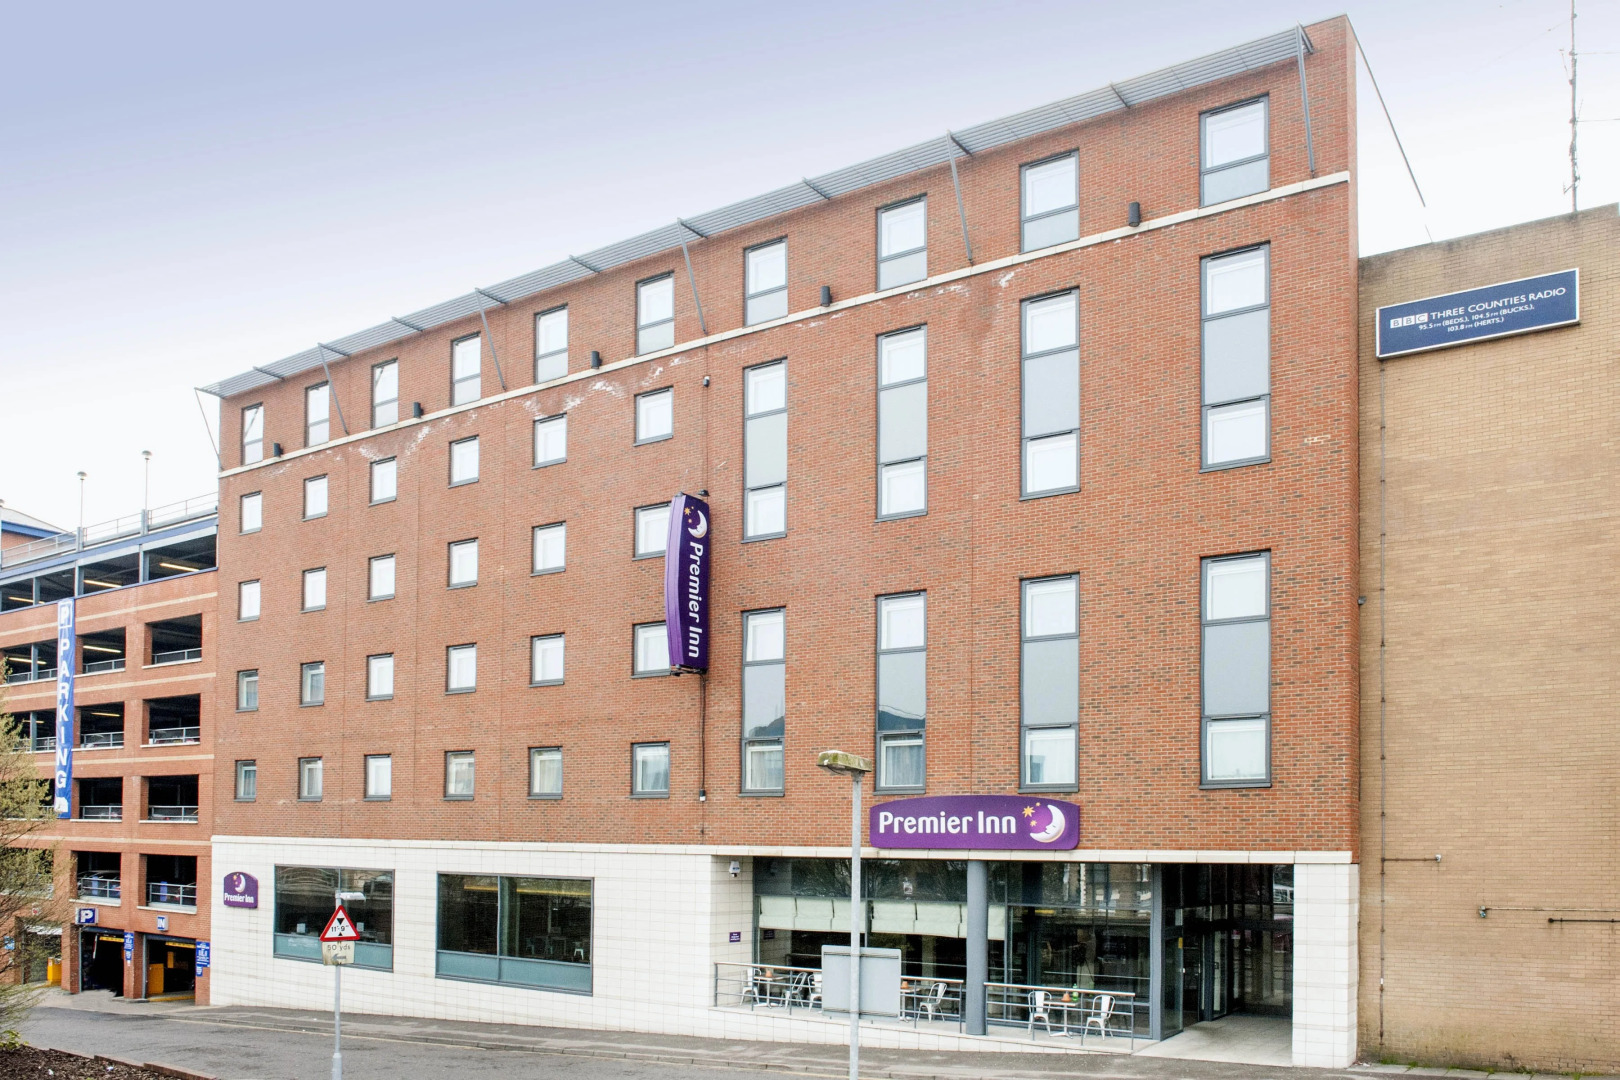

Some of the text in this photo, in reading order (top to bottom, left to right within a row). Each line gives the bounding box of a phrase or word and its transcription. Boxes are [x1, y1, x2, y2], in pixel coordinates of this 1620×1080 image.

[1390, 287, 1566, 328] BBC THREE COUNTIES RADIO
[688, 541, 703, 658] Premier Inn
[56, 638, 71, 789] PARKING
[879, 811, 1016, 834] Premier Inn
[224, 893, 254, 903] Premier Inn
[80, 910, 93, 922] P
[157, 916, 165, 930] IN
[339, 943, 351, 952] yds
